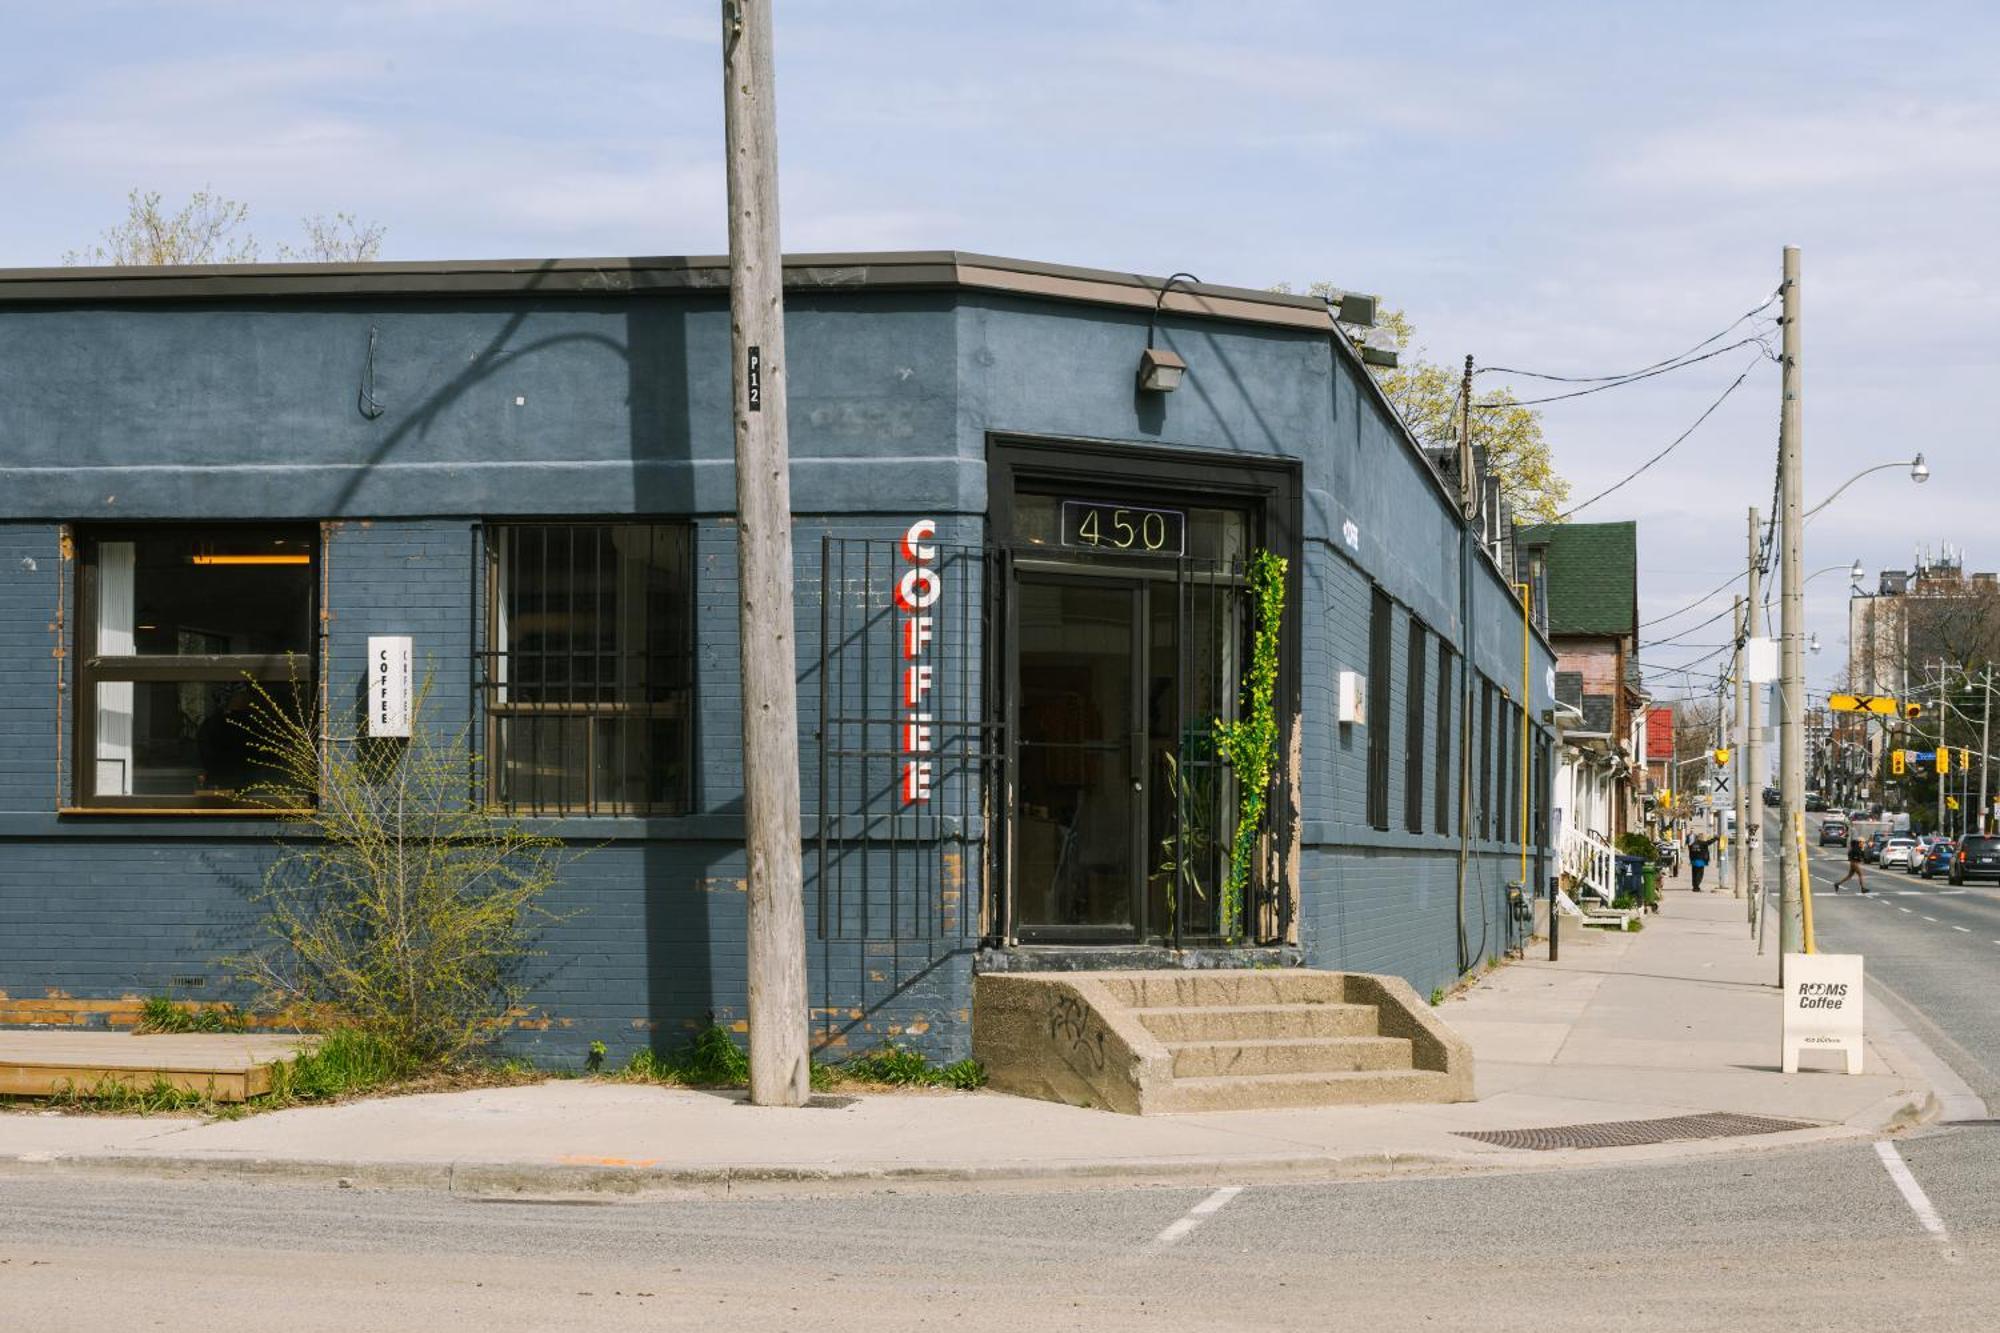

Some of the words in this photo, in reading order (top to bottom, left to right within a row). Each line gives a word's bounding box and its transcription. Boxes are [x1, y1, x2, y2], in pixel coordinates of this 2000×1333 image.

[750, 356, 759, 402] P12
[1079, 509, 1165, 550] 450
[896, 519, 942, 804] COFFEE
[380, 649, 388, 724] COFFEE
[1799, 983, 1848, 996] ROOMS
[1799, 996, 1843, 1010] Coffee
